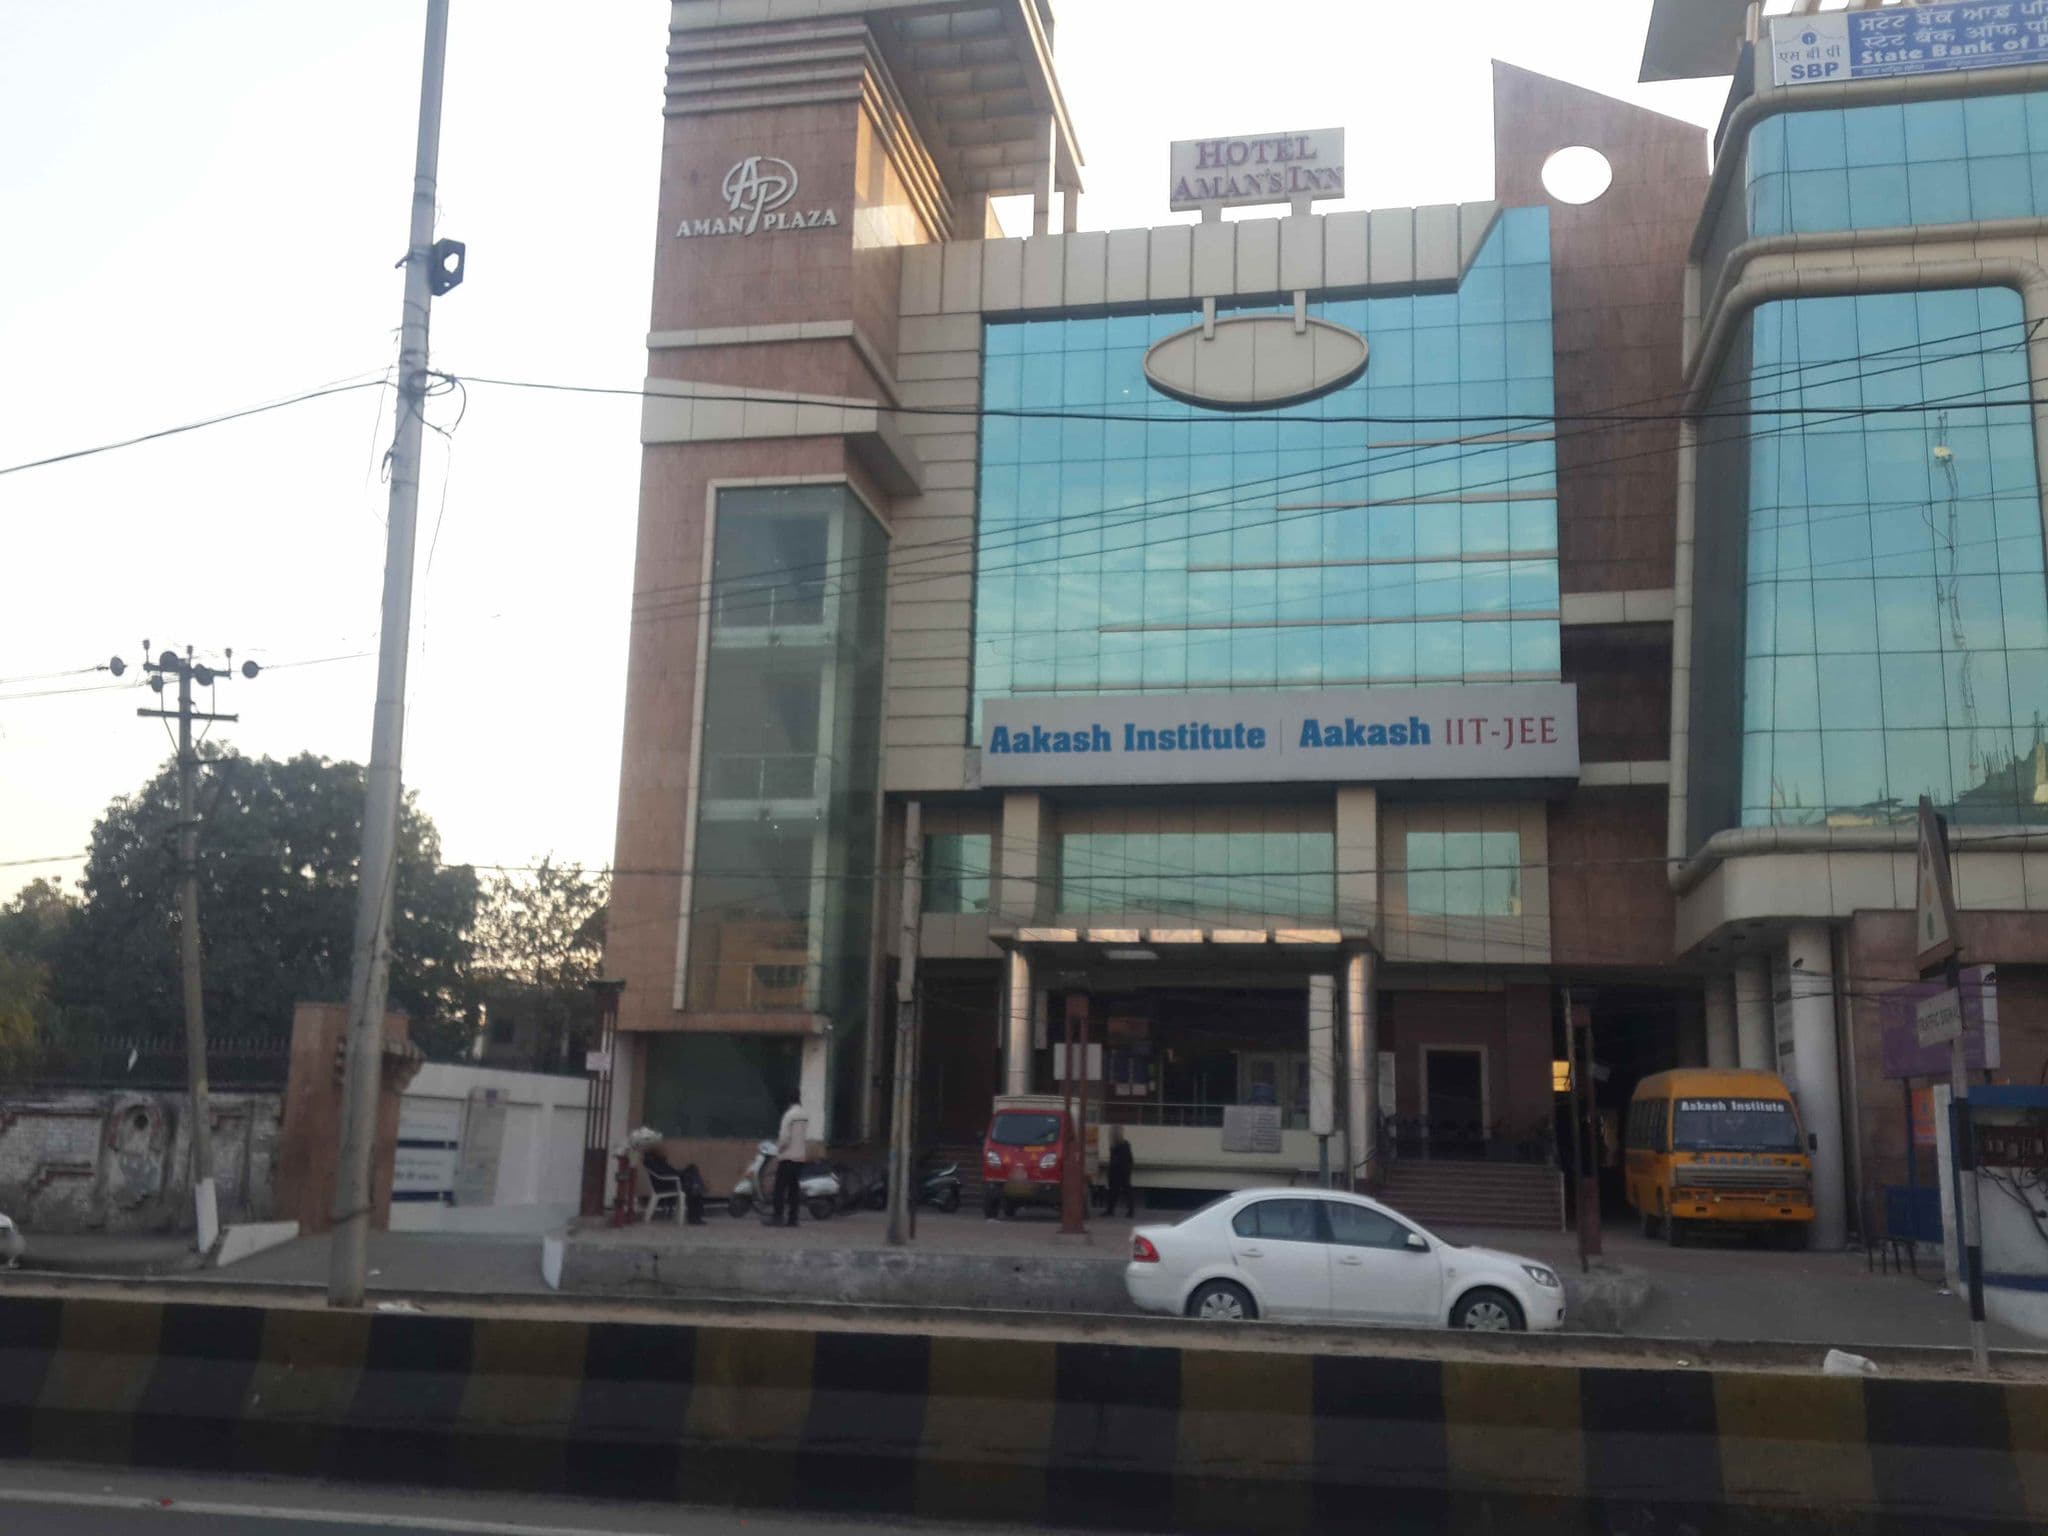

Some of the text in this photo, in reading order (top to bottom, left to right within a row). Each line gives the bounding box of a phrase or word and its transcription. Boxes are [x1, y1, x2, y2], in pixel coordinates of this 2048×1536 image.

[1861, 48, 1923, 64] State
[1932, 40, 1995, 58] Bank
[2002, 35, 2030, 50] of
[1791, 61, 1840, 80] SBP
[1195, 135, 1318, 169] HOTEL
[676, 207, 838, 238] AMAN PLAZA
[990, 721, 1266, 754] Aakash Institute
[1298, 715, 1559, 750] Aakash IIT-JEE
[1680, 1100, 1785, 1113] Aakash Institute
